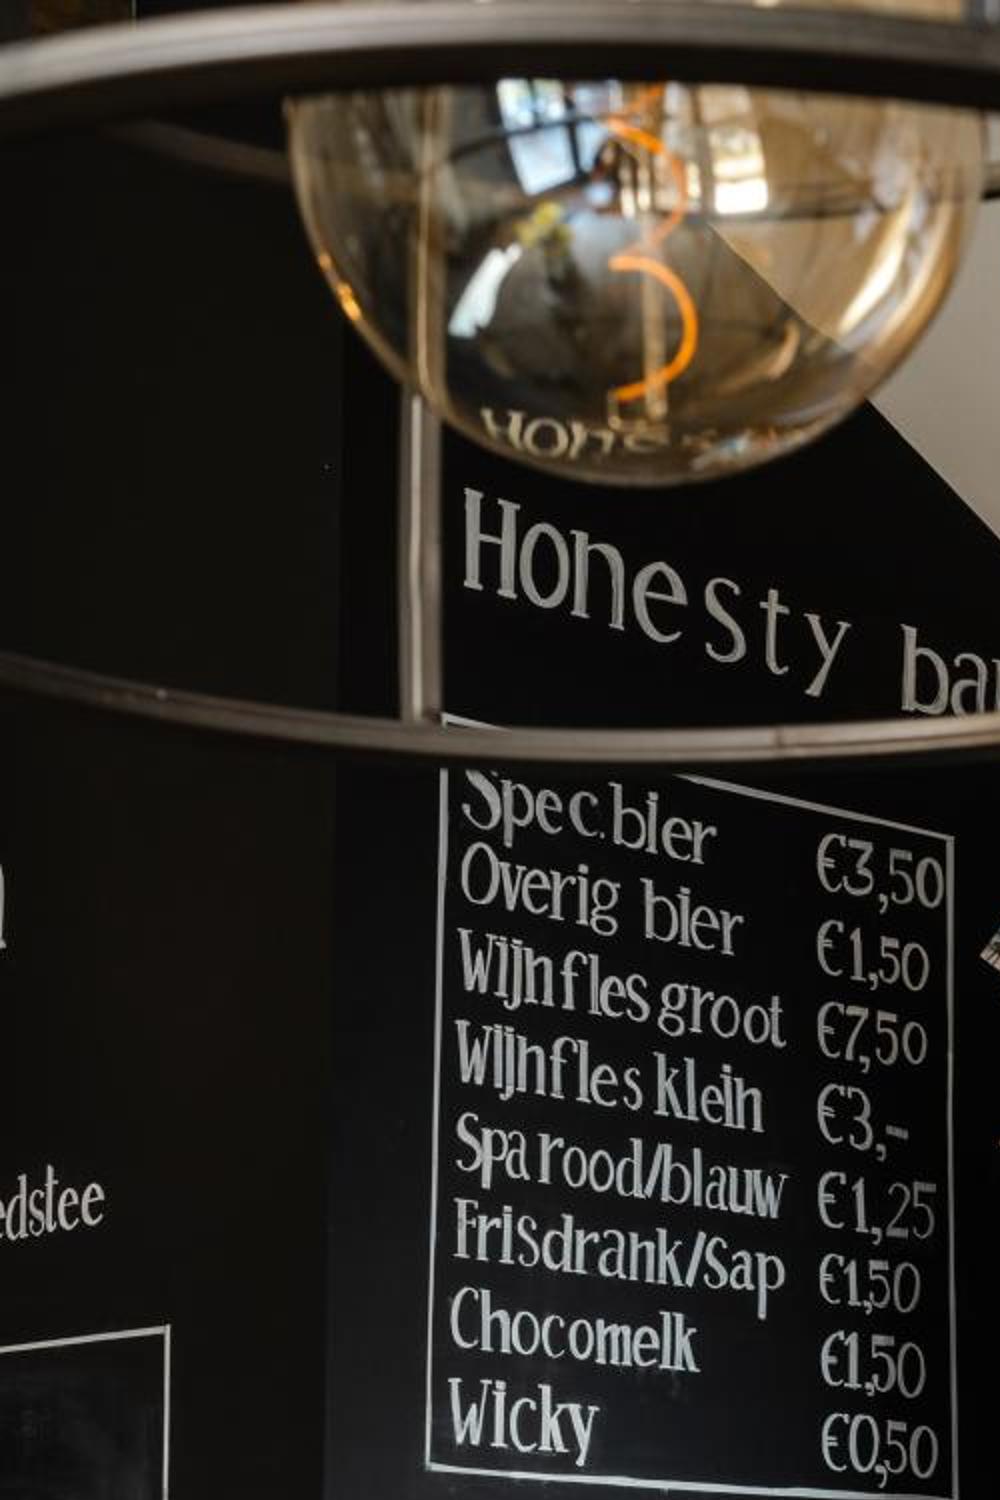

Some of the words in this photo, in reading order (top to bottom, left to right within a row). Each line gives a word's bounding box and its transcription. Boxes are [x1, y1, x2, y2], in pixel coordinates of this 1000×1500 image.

[462, 487, 852, 698] Honesty
[460, 841, 621, 937] Overig
[640, 876, 745, 957] bier
[816, 919, 931, 991] €1,50
[816, 832, 945, 914] €3,50
[656, 982, 787, 1049] groot
[816, 1001, 929, 1074] €7,50
[652, 1051, 766, 1134] klein
[816, 1083, 910, 1161] €3,-
[0, 1164, 105, 1240] dstee
[817, 1170, 938, 1246] €1,25
[818, 1252, 922, 1316] €1,50
[449, 1286, 701, 1374] Chocomelk
[820, 1329, 927, 1399] €1,50
[447, 1377, 601, 1467] Wicky
[821, 1411, 940, 1490] €0,50
